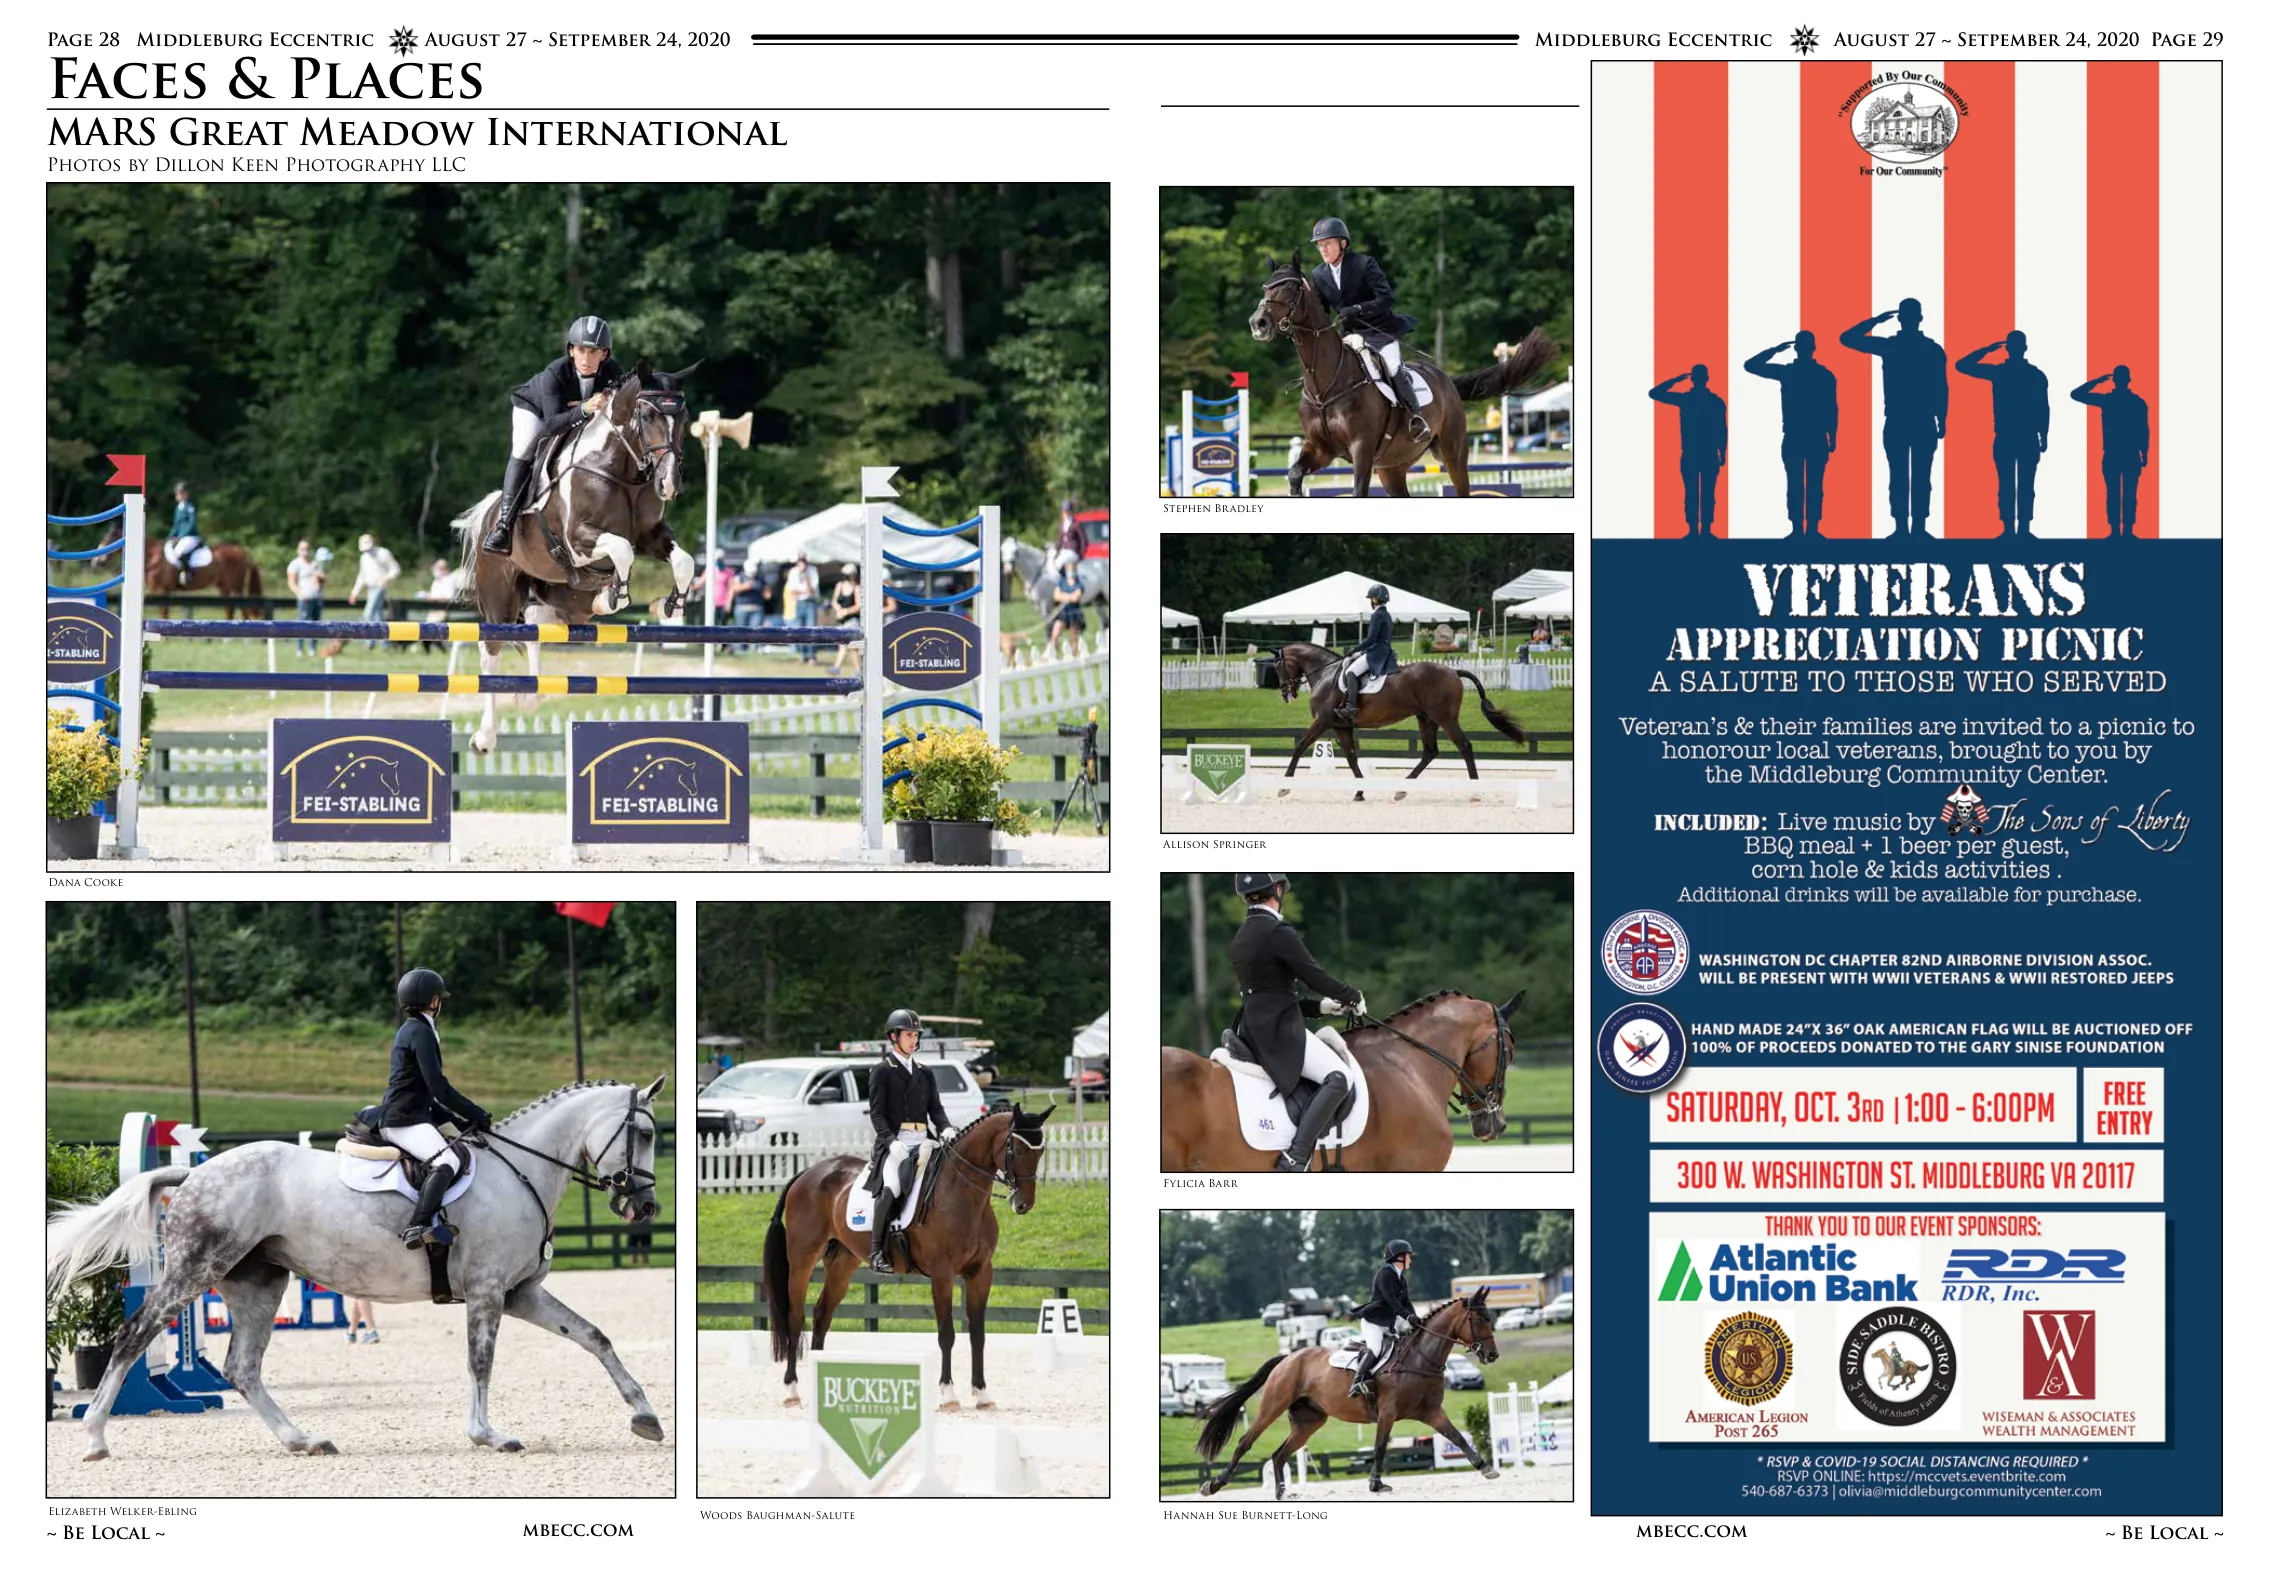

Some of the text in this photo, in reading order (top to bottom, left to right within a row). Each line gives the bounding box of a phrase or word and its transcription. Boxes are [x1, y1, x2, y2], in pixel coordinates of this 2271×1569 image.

[99, 32, 119, 46] 28
[506, 32, 526, 46] 27
[657, 32, 681, 48] 24,
[688, 32, 730, 46] 2020
[1915, 32, 1935, 46] 27
[2066, 32, 2090, 48] 24,
[2097, 32, 2139, 46] 2020
[2203, 32, 2223, 46] 29
[1838, 74, 1969, 118] "Supported Community
[48, 117, 155, 146] MARS
[433, 157, 465, 171] LLC
[1860, 166, 1948, 178] For Our Community"
[1744, 563, 2085, 616] VETERANS
[1666, 627, 2143, 661] APPRECIATION PICNIC
[900, 658, 961, 668] FEI-STABLING
[1681, 671, 2166, 692] SALUTE THOSE SERVED
[1760, 718, 1816, 735] their
[1823, 717, 1912, 735] families
[1963, 718, 2044, 735] invited
[2098, 718, 2166, 739] picnic
[1194, 753, 1243, 768] BUCKEYE
[1662, 741, 2041, 763] honorour local veterans, brought
[1749, 762, 2107, 787] Middleburg Community Center.
[304, 796, 420, 812] FEI-STABLING
[603, 797, 718, 813] FEI-STABLING
[1655, 813, 1903, 832] INCLUDED: music
[2118, 789, 2190, 852] Liberty
[1744, 836, 2069, 859] BBQ guest,
[1945, 861, 2049, 878] activities
[1678, 887, 2141, 906] Additional drinks available purchase.
[1699, 954, 2151, 966] WASHINGTON CHAPTER AIRBORNE DIVISION ASSOC.
[1761, 972, 2173, 984] PRESENT VETERANS RESTORED JEEPS
[1889, 1024, 2160, 1034] AMERICAN AUCTIONED
[1760, 1042, 2164, 1053] PROCEEDS DONATED SINISE FOUNDATION
[2105, 1082, 2145, 1105] FREE
[1664, 1088, 1786, 1127] SATURDAY,
[1795, 1092, 1839, 1122] OCT.
[1905, 1093, 1948, 1122] 1:00
[1973, 1093, 2054, 1122] 6:00PM
[1258, 1117, 1275, 1130] 461
[2096, 1108, 2154, 1137] ENTRY
[1678, 1161, 2134, 1188] 300 WASHINGTON MIDDLEBURG 20117
[1765, 1214, 2042, 1237] THANK EVENT SPONSORS:
[1710, 1243, 1856, 1271] Atlantic
[1943, 1249, 2126, 1278] RDR
[1710, 1274, 1918, 1301] Union Bank
[1942, 1286, 2039, 1303] RDR, Inc.
[1716, 1321, 1783, 1349] AMERICAN
[1846, 1314, 1950, 1375] SIDE SADDLE BISTRO
[823, 1376, 916, 1410] BUCKEYE
[1724, 1381, 1775, 1397] LEGION
[838, 1404, 900, 1414] NUTRITION
[1858, 1392, 1920, 1418] Fields Athenry
[1983, 1412, 2135, 1422] WISEMAN ASSOCIATES
[1752, 1425, 1778, 1437] 265
[1983, 1426, 2135, 1436] WEALTH MANAGEMENT
[1815, 1456, 2078, 1467] COVID-19 SOCIAL DISTANCING REQUIRED
[1778, 1470, 2065, 1484] RSVP ONLINE: https://mccvets.eventbrite.com
[1742, 1482, 2101, 1500] 540-687-6373 olivia@middleburgcommunitycenter.com
